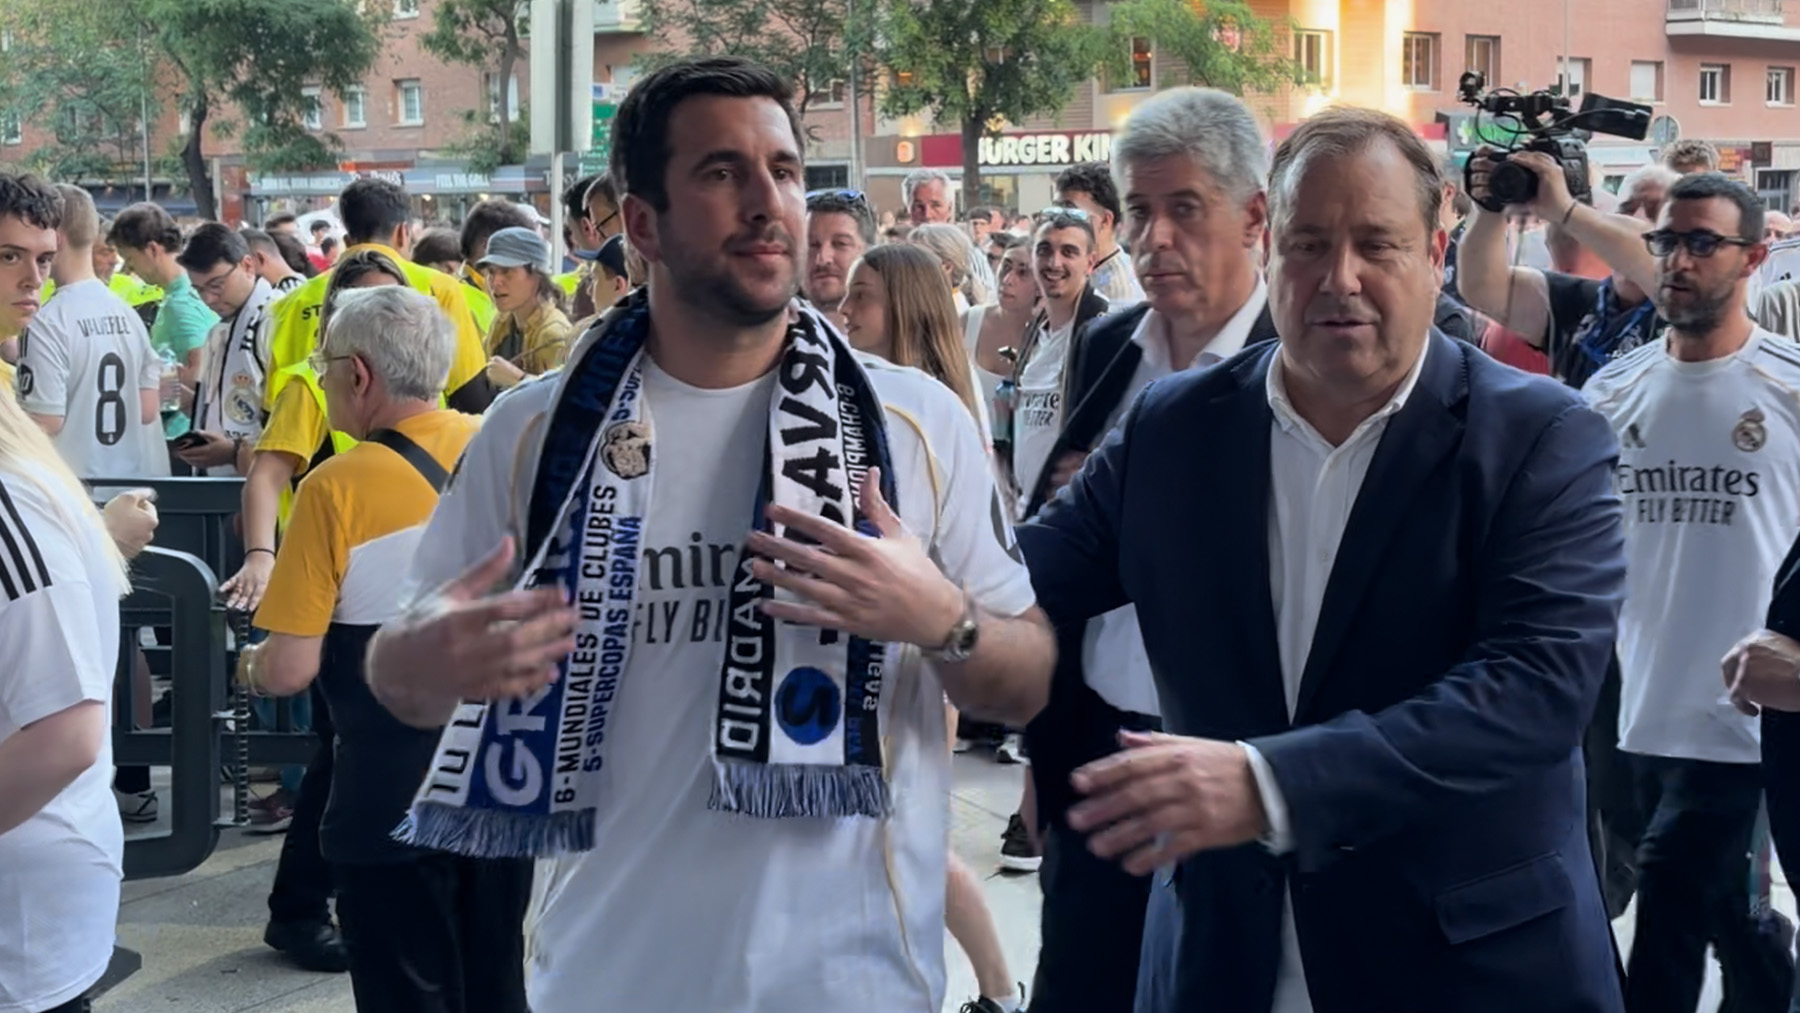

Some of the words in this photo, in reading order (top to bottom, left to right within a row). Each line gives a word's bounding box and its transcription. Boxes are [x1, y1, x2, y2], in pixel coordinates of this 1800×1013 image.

[1073, 132, 1110, 162] KIN
[96, 352, 127, 446] 8
[1617, 460, 1760, 497] Emirates
[1638, 498, 1666, 524] FLY
[581, 485, 617, 579] CLUBES
[582, 608, 629, 772] 5-SUPERCOPAS
[609, 516, 642, 601] ESPAÑA
